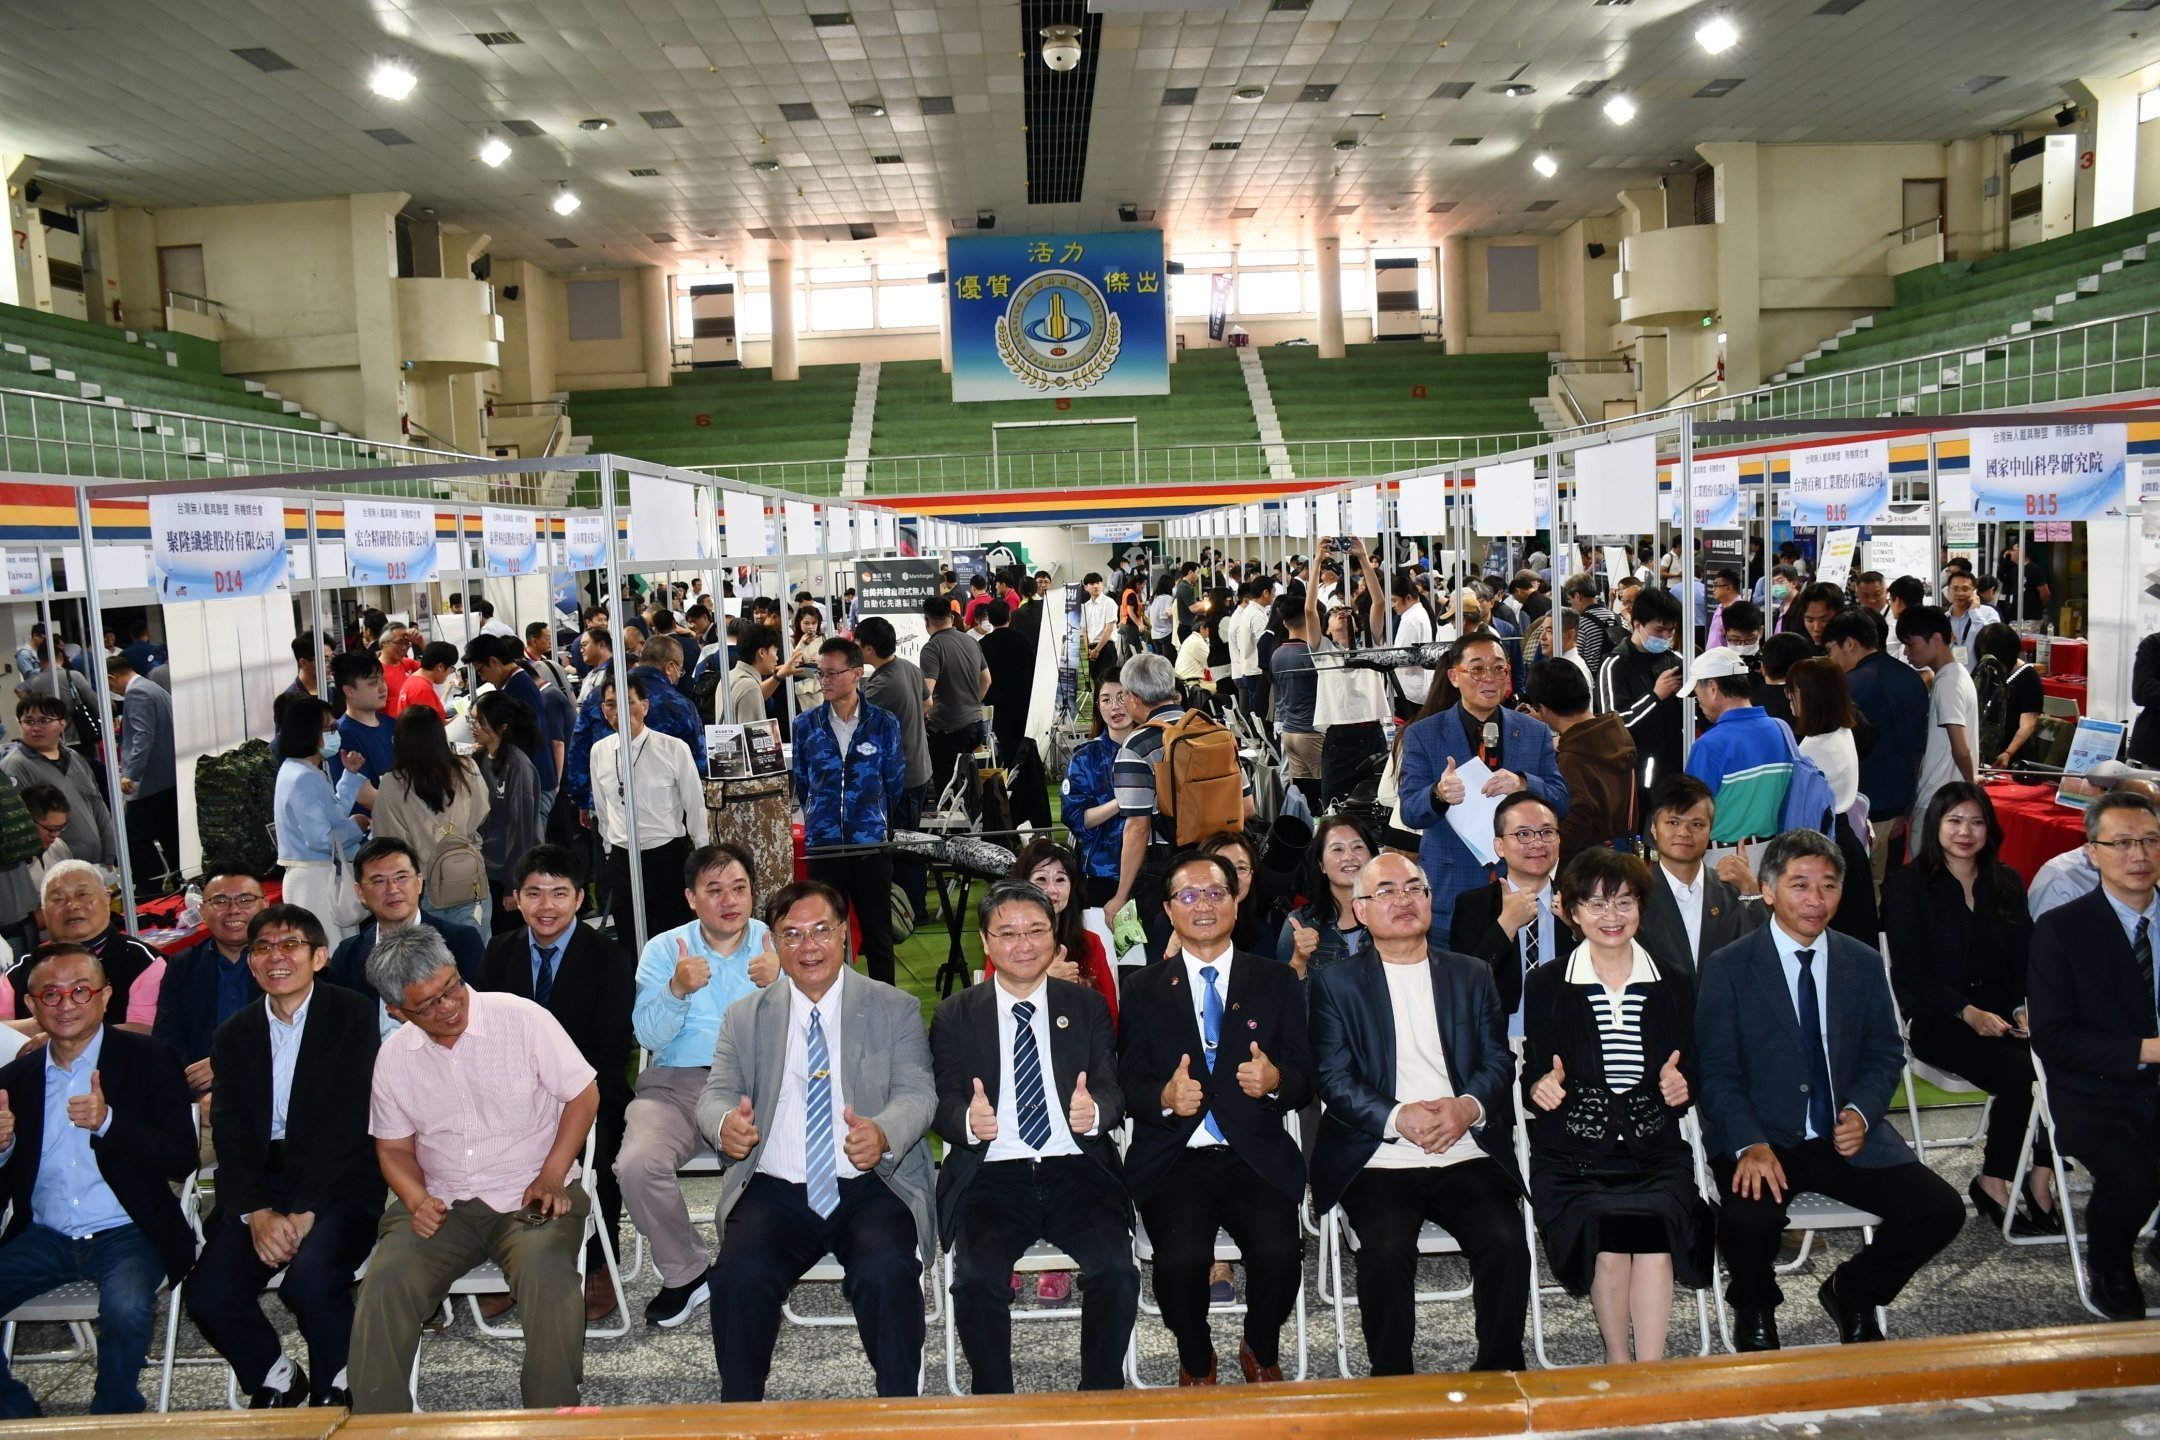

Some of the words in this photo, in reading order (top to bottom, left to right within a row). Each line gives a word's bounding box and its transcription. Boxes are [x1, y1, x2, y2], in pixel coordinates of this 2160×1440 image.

[2080, 151, 2094, 170] 3
[14, 229, 27, 250] 7
[1027, 241, 1084, 264] 活力
[955, 274, 1012, 300] 優質
[1103, 271, 1159, 294] 傑出
[1412, 385, 1426, 398] 4
[1056, 397, 1071, 411] 5
[696, 414, 711, 427] 6
[1993, 427, 2048, 443] 台灣無人載具聯盟
[1986, 451, 2103, 479] 國家中山科學研究院
[1794, 471, 1883, 492] 台灣百和工業股份有限公司
[1826, 504, 1847, 521] B16
[2026, 493, 2058, 516] B15
[1696, 509, 1710, 523] B17
[167, 530, 275, 553] 聚隆纖維股份有限公司
[387, 562, 407, 580] D13
[508, 558, 520, 573] D12
[215, 570, 243, 593] D14
